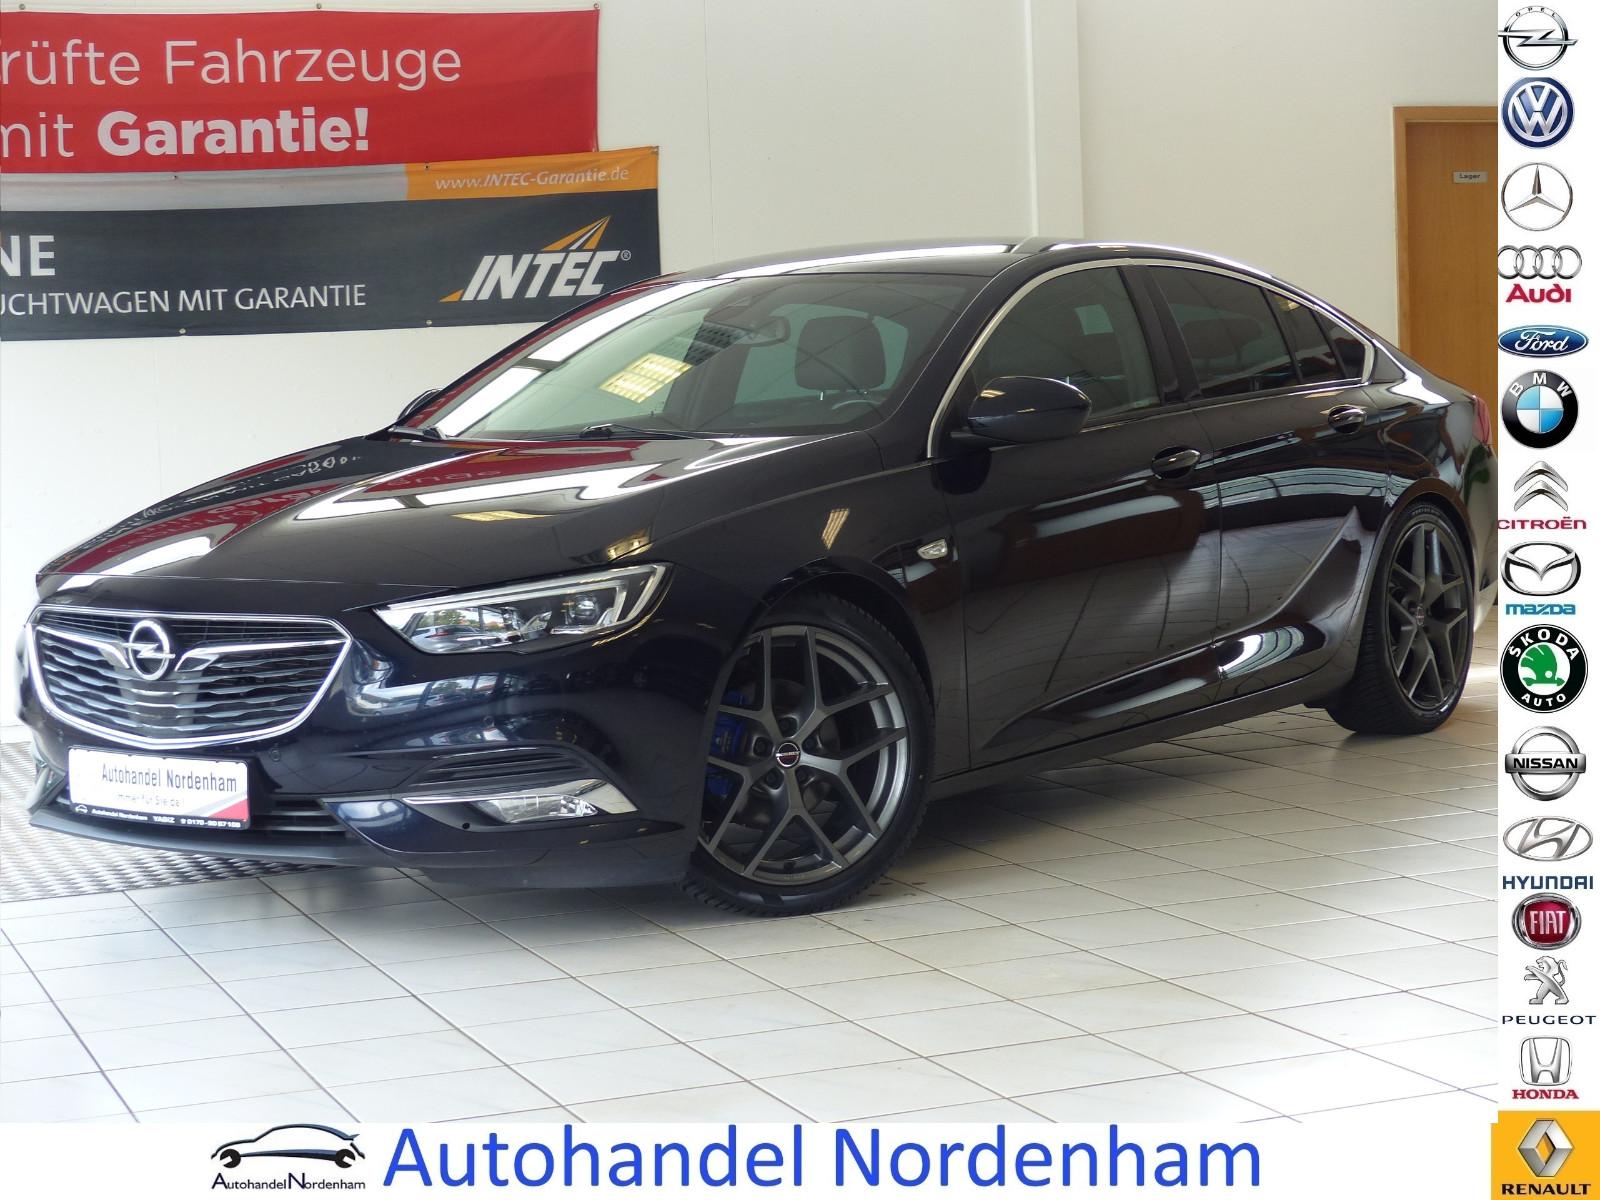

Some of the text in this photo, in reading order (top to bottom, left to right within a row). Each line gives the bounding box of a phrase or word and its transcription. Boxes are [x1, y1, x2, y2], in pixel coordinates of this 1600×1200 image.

[165, 39, 462, 91] Fahrzeuge
[97, 106, 370, 157] Garantie!
[435, 166, 630, 190] www.INTEC-Garantie.de
[1459, 172, 1481, 180] Lager
[0, 284, 367, 316] CHTWAGEN MIT GARANTIE
[102, 763, 237, 792] Autohandel Nordenham
